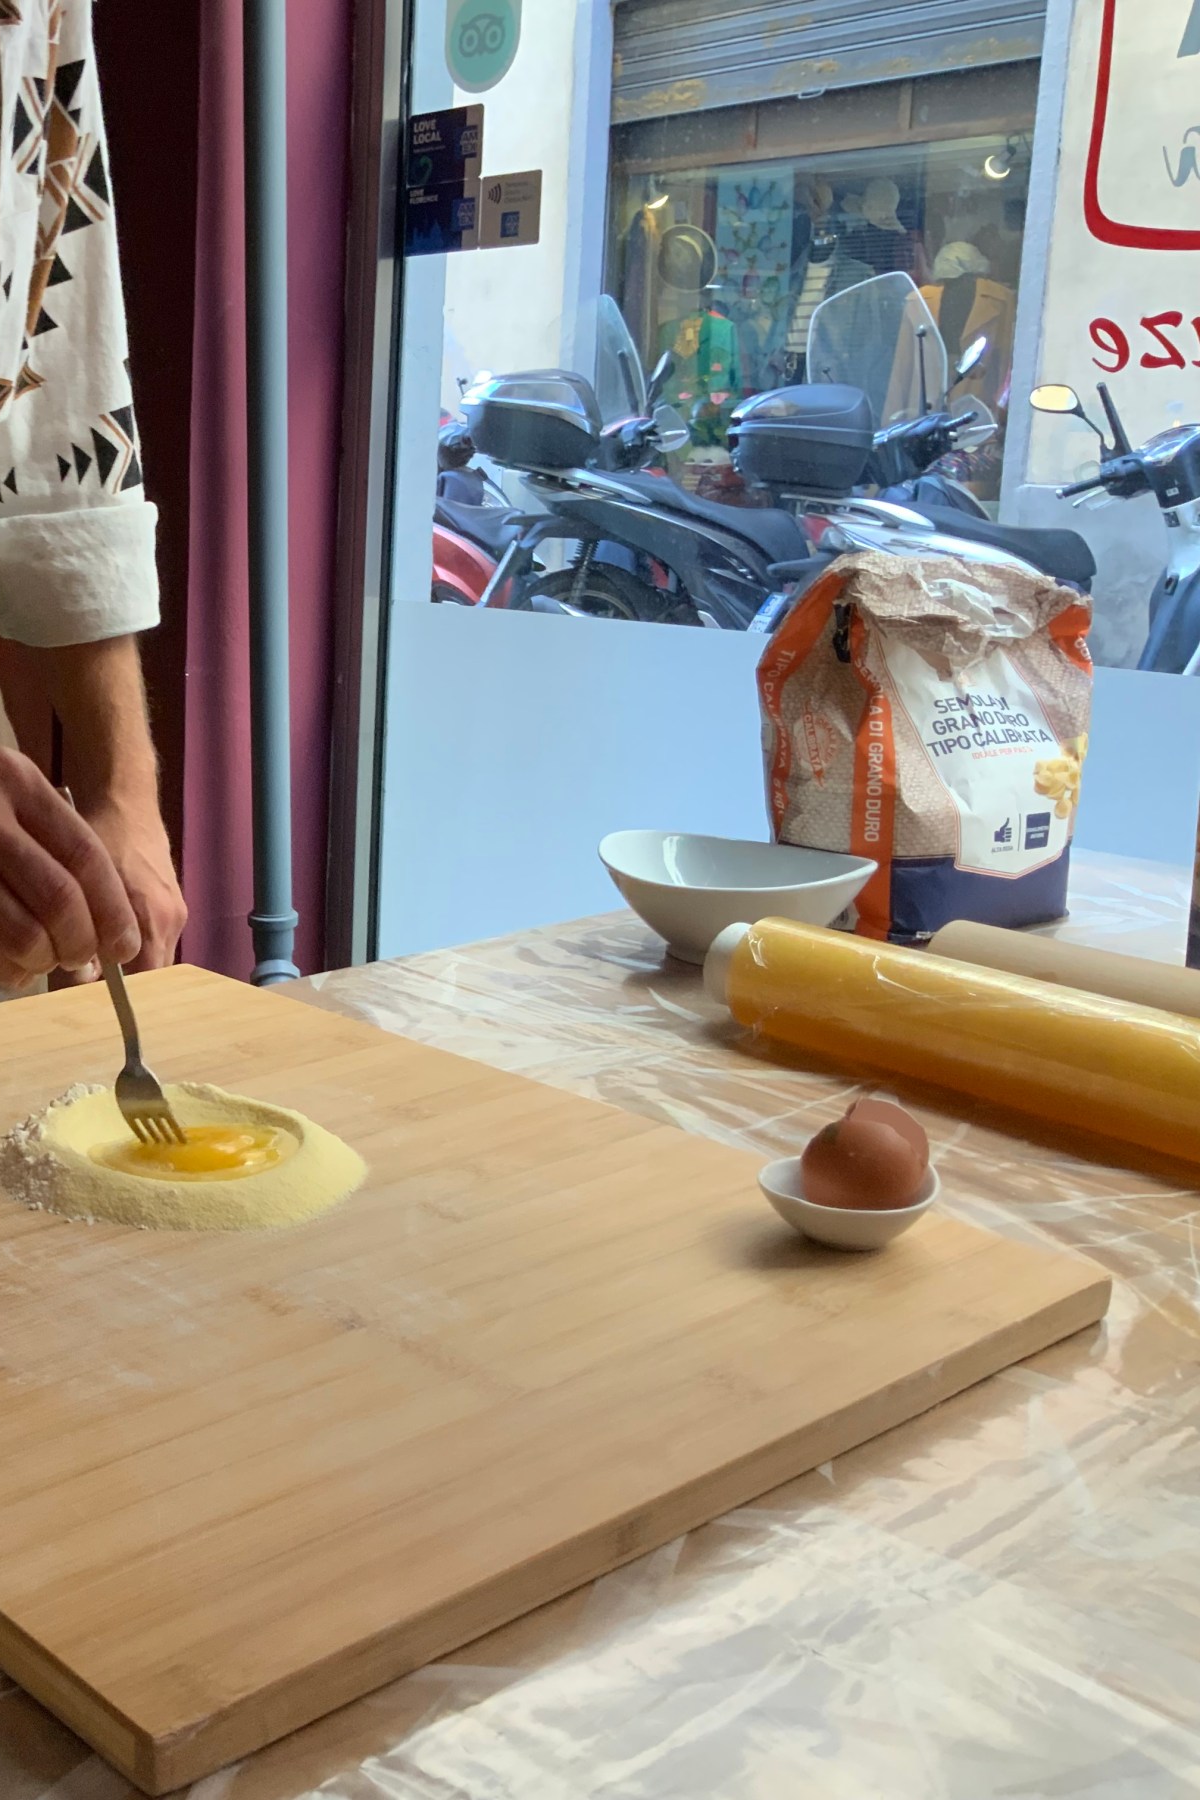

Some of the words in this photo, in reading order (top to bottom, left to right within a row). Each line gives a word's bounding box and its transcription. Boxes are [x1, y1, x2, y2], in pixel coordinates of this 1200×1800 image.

[413, 119, 437, 134] LOVE
[413, 130, 442, 145] LOCAL
[767, 649, 797, 678] TIPO
[868, 720, 884, 737] DI
[932, 711, 995, 735] GRANO
[926, 735, 972, 757] TIPO
[866, 742, 884, 796] GRANO
[863, 799, 881, 842] DURO
